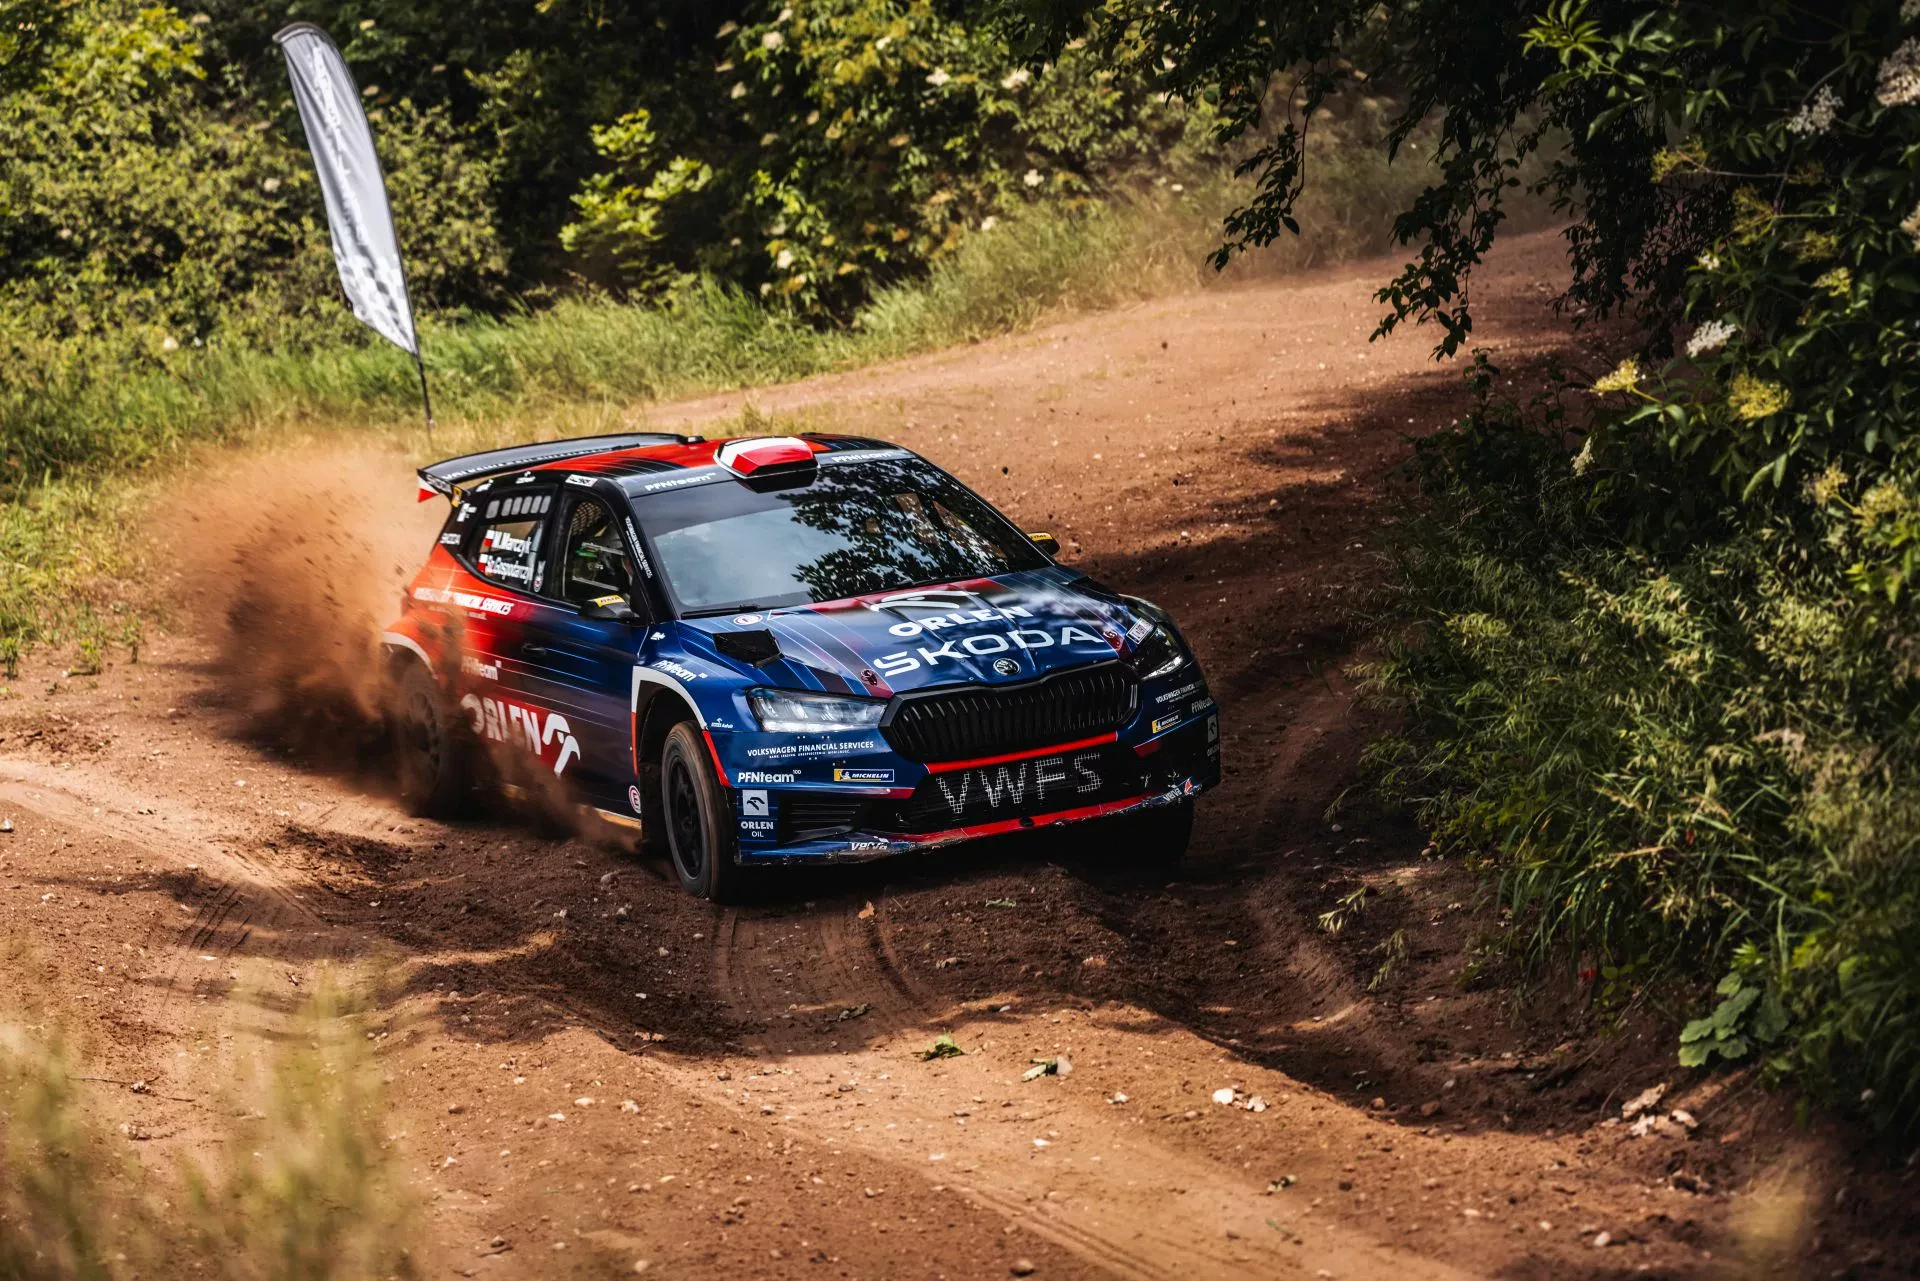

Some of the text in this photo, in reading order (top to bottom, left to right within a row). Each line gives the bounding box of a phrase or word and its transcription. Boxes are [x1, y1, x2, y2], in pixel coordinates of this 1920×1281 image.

[888, 606, 1034, 637] ORLEN
[873, 626, 1105, 677] SKODA
[747, 745, 797, 757] VOLKSWAGEN
[798, 742, 838, 752] FINANCIAL
[839, 740, 875, 750] SERVICES
[740, 820, 775, 830] ORLEN
